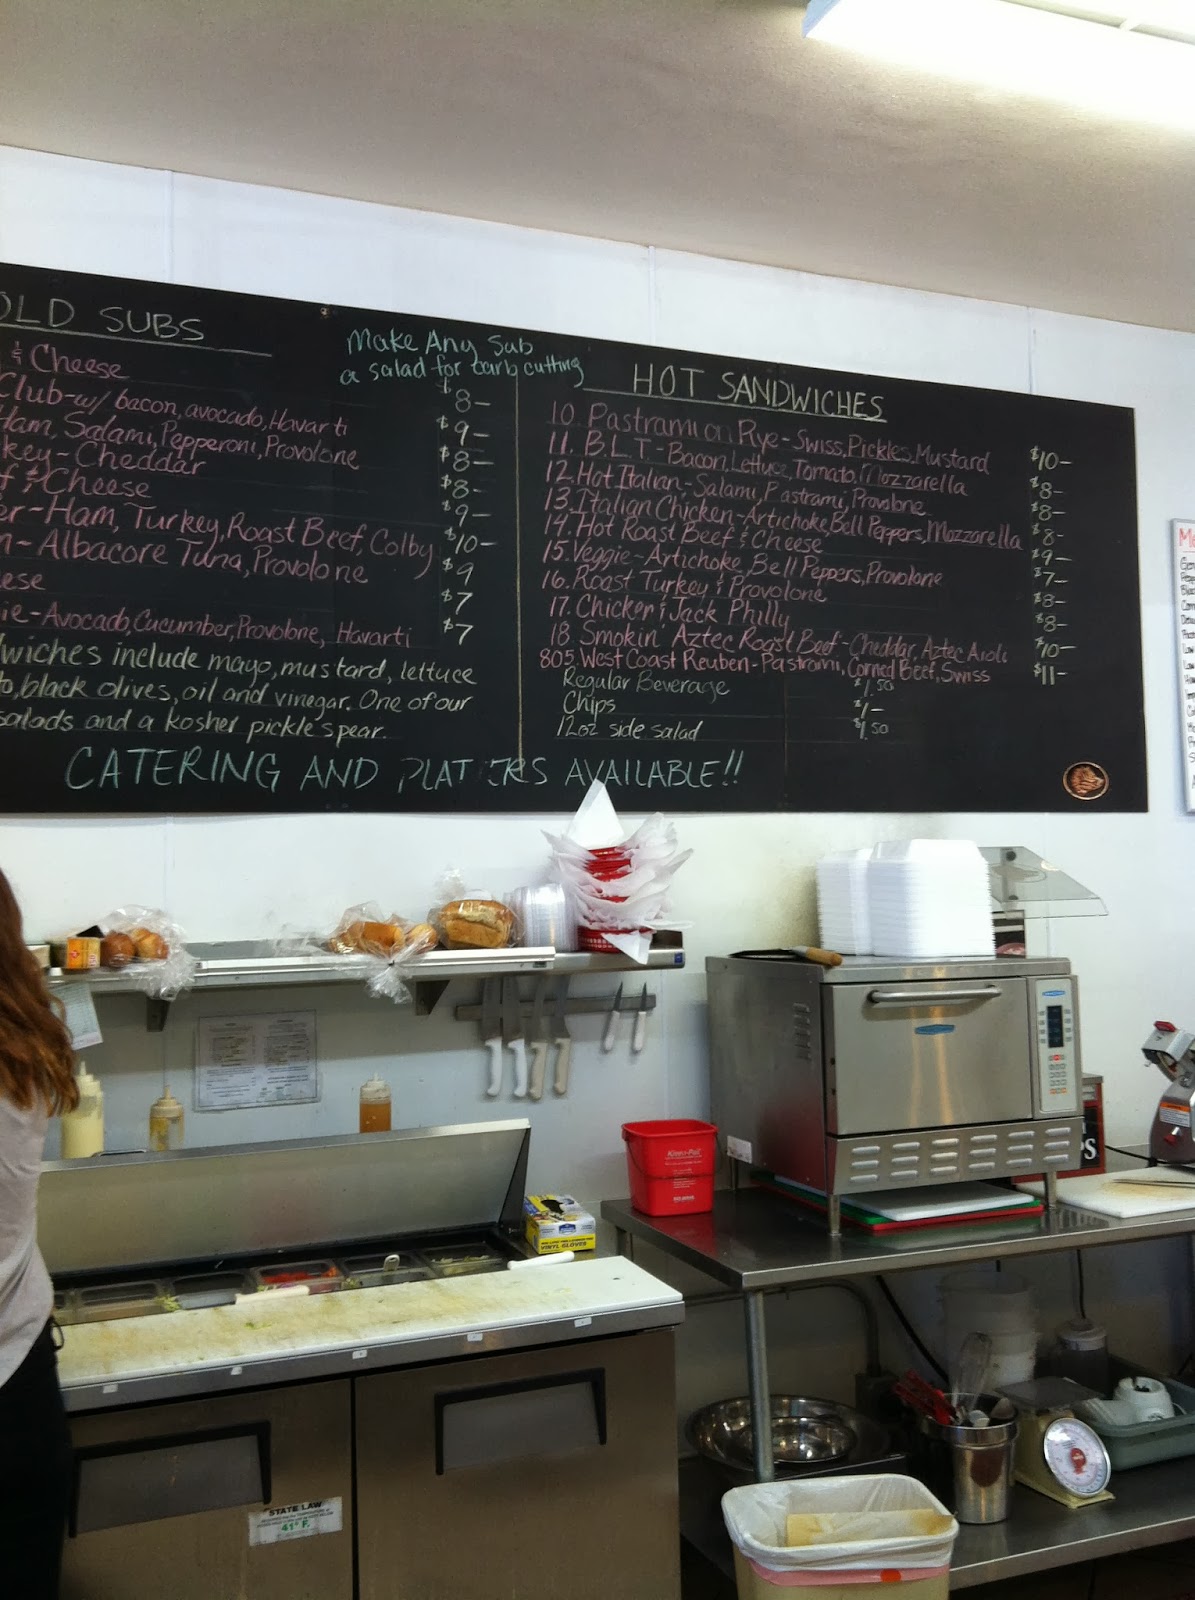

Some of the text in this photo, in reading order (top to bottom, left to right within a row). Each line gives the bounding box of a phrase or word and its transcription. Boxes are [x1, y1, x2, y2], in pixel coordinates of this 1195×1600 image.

[100, 306, 204, 340] SUBS
[347, 327, 534, 361] Make Any Sub
[30, 344, 130, 379] Cheese
[369, 356, 427, 381] salad
[431, 353, 462, 378] for
[524, 356, 585, 388] cutting
[633, 363, 885, 419] HOT SANDWICHES
[588, 402, 699, 438] Pastrami
[916, 443, 991, 475] Mustard
[75, 441, 206, 475] Cheddar
[42, 468, 152, 499] Cheese
[577, 461, 614, 490] Hot
[572, 489, 651, 515] Italian
[830, 512, 864, 536] Bell
[227, 511, 295, 545] Roast
[370, 528, 433, 580] Colby
[576, 513, 614, 537] Hot
[622, 516, 676, 543] Roast
[681, 521, 735, 548] Beef
[751, 529, 823, 554] Cheese
[37, 528, 168, 565] Albacore
[253, 545, 369, 584] Provolone
[751, 553, 798, 579] Bell
[572, 564, 634, 593] Roast
[639, 568, 709, 600] Turkey
[729, 574, 827, 602] Provolone
[669, 597, 718, 623] Jack
[336, 621, 413, 649] Havarti
[671, 623, 735, 653] Aztec
[112, 641, 202, 670] include
[400, 660, 478, 686] lettuce
[580, 648, 623, 670] West
[626, 648, 677, 670] Coast
[20, 672, 88, 699] black
[181, 677, 219, 704] oil
[222, 682, 271, 705] and
[359, 689, 402, 713] One
[408, 692, 438, 711] of
[435, 695, 474, 712] our
[563, 666, 731, 704] Regular Beverage
[0, 706, 74, 732] salads
[85, 708, 133, 732] and
[137, 715, 154, 732] a
[164, 706, 240, 734] kosher
[563, 690, 617, 722] Chips
[556, 715, 704, 742] 12oz side salad
[65, 745, 281, 793] CATERING
[300, 755, 379, 792] AND
[269, 1501, 323, 1517] STATE LAW
